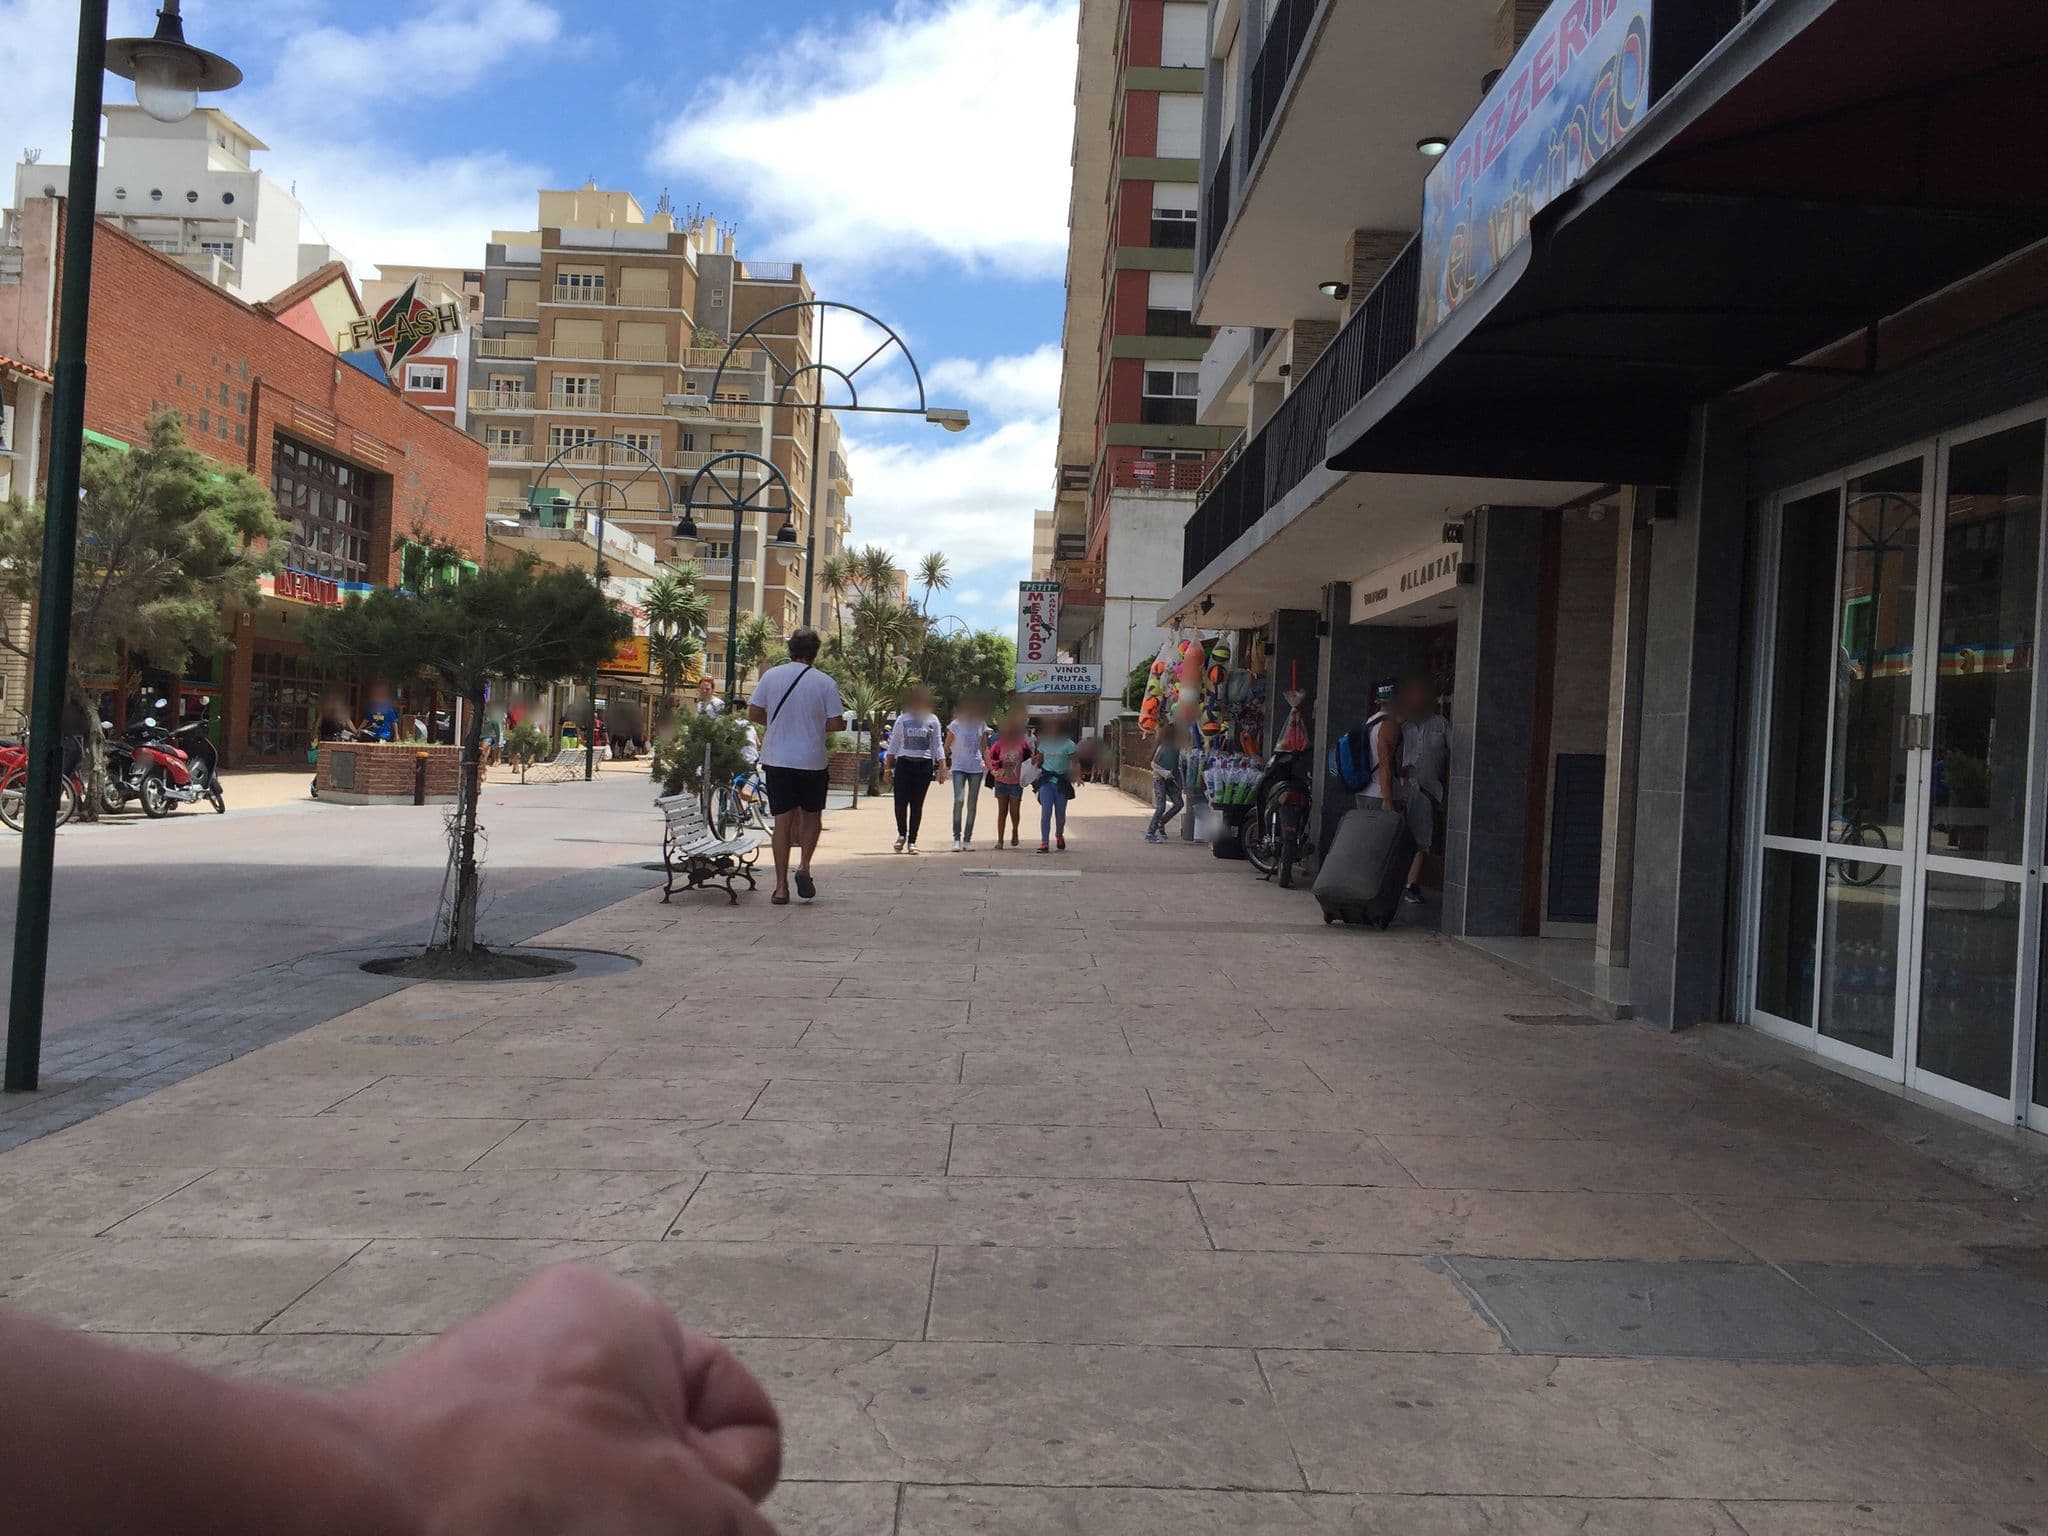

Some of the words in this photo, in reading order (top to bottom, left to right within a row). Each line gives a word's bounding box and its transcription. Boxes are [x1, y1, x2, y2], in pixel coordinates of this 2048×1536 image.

[1452, 0, 1617, 207] PIZZERI
[350, 303, 460, 349] FLASH
[1400, 551, 1459, 593] OLLANTAY
[1027, 592, 1044, 661] MERCADO
